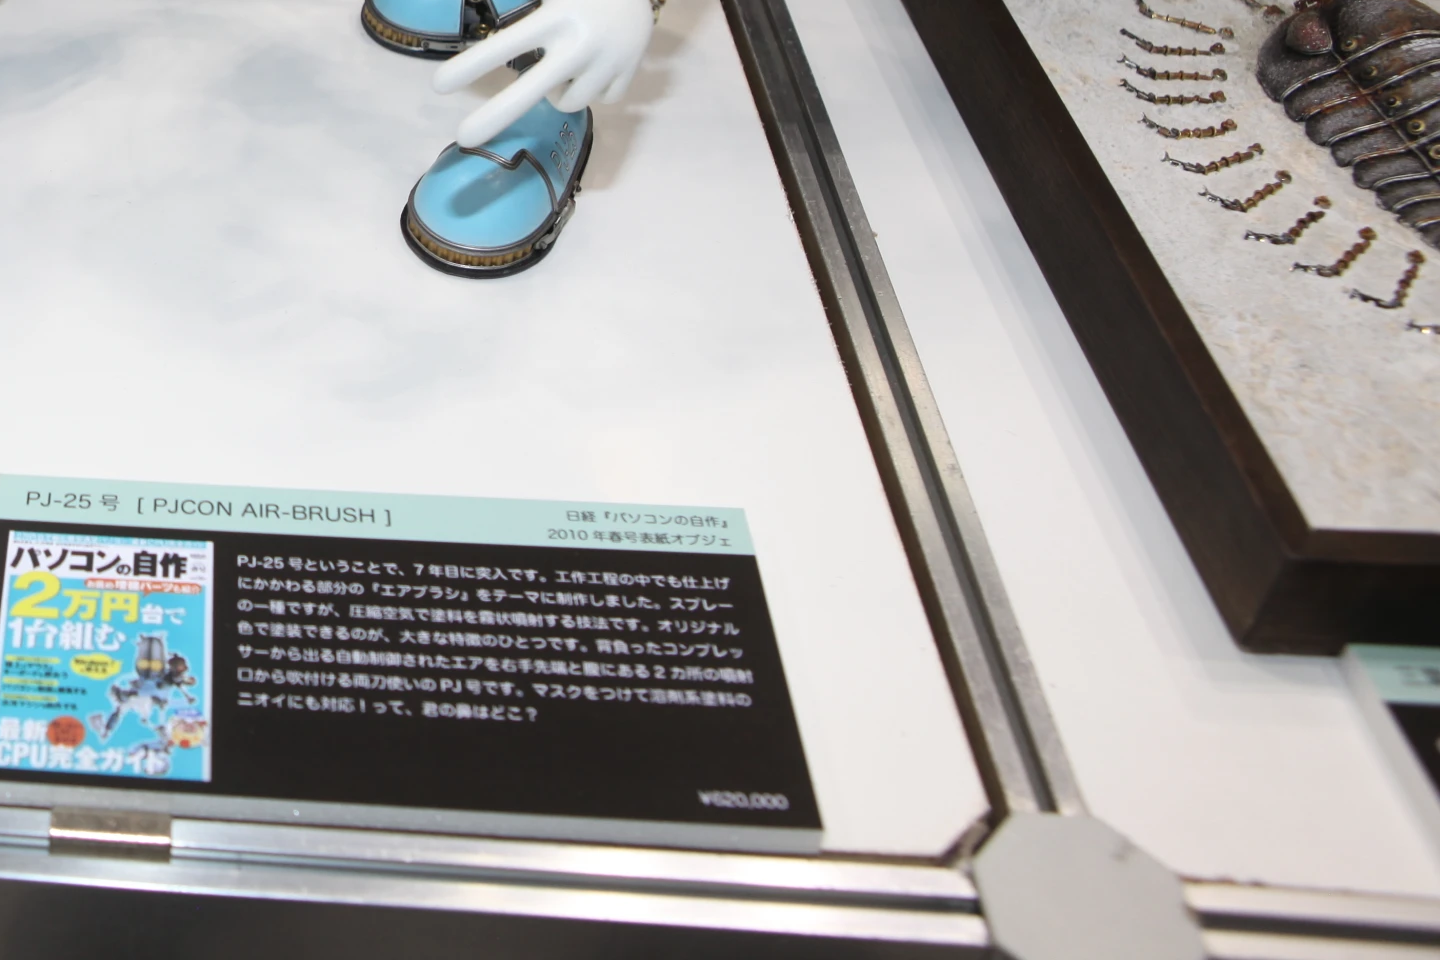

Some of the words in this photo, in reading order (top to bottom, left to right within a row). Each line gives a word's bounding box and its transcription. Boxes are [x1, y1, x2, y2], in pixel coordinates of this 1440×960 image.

[26, 491, 93, 510] PJ-25
[98, 494, 120, 513] 号
[154, 498, 233, 518] PJCON
[242, 503, 377, 524] AIR-BRUSH
[566, 509, 729, 529] 日経『パソコンの自作』
[548, 528, 589, 541] 2010
[10, 546, 187, 578] パソコンの自作
